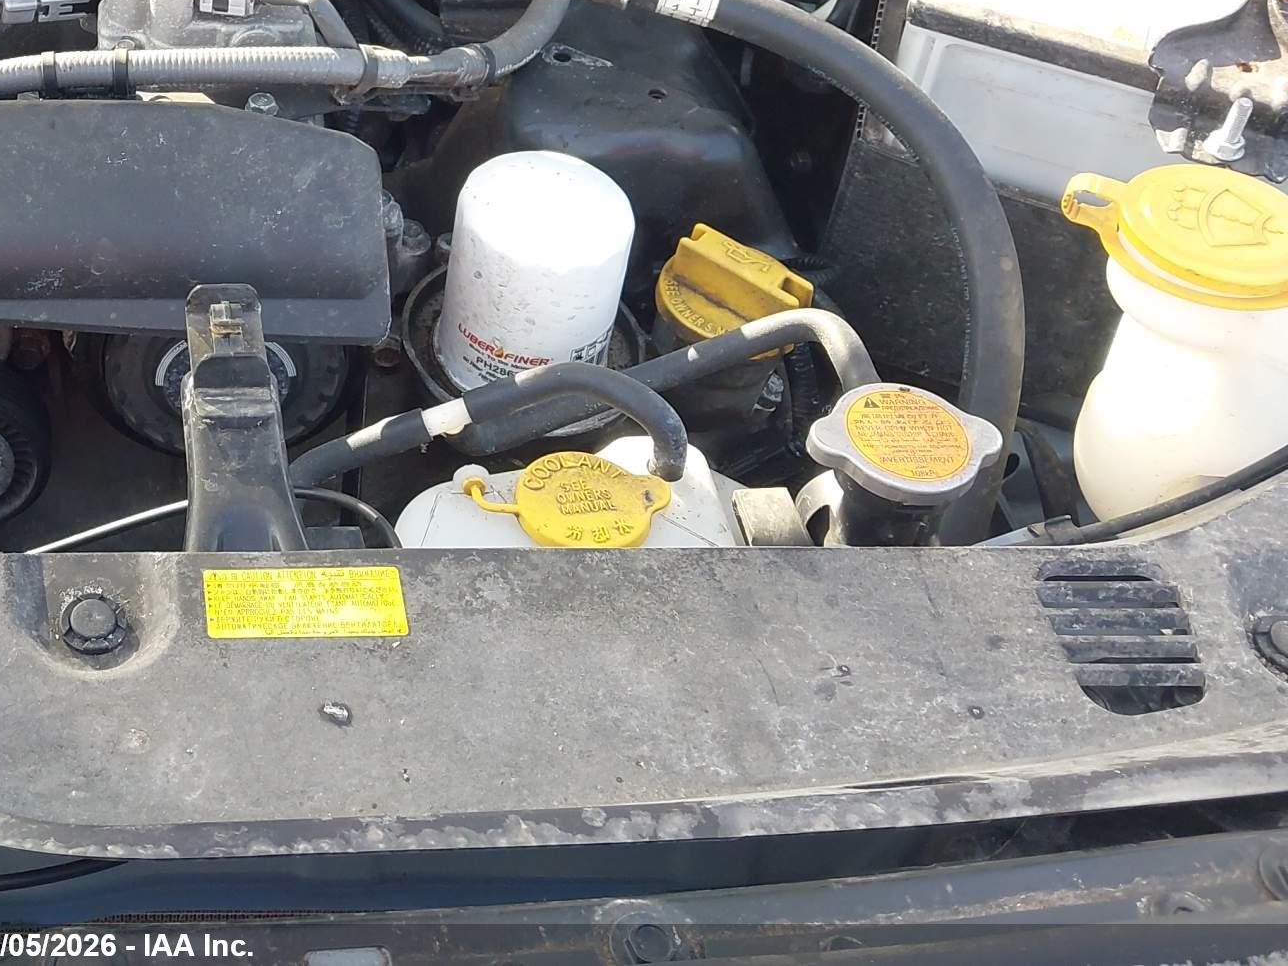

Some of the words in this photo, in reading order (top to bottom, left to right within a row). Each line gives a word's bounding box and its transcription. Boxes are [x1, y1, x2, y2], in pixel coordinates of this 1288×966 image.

[504, 353, 551, 367] FINER
[522, 454, 626, 491] COOLANT
[560, 481, 589, 493] SEE
[556, 489, 612, 505] OWNERS
[559, 500, 617, 516] MANUAL
